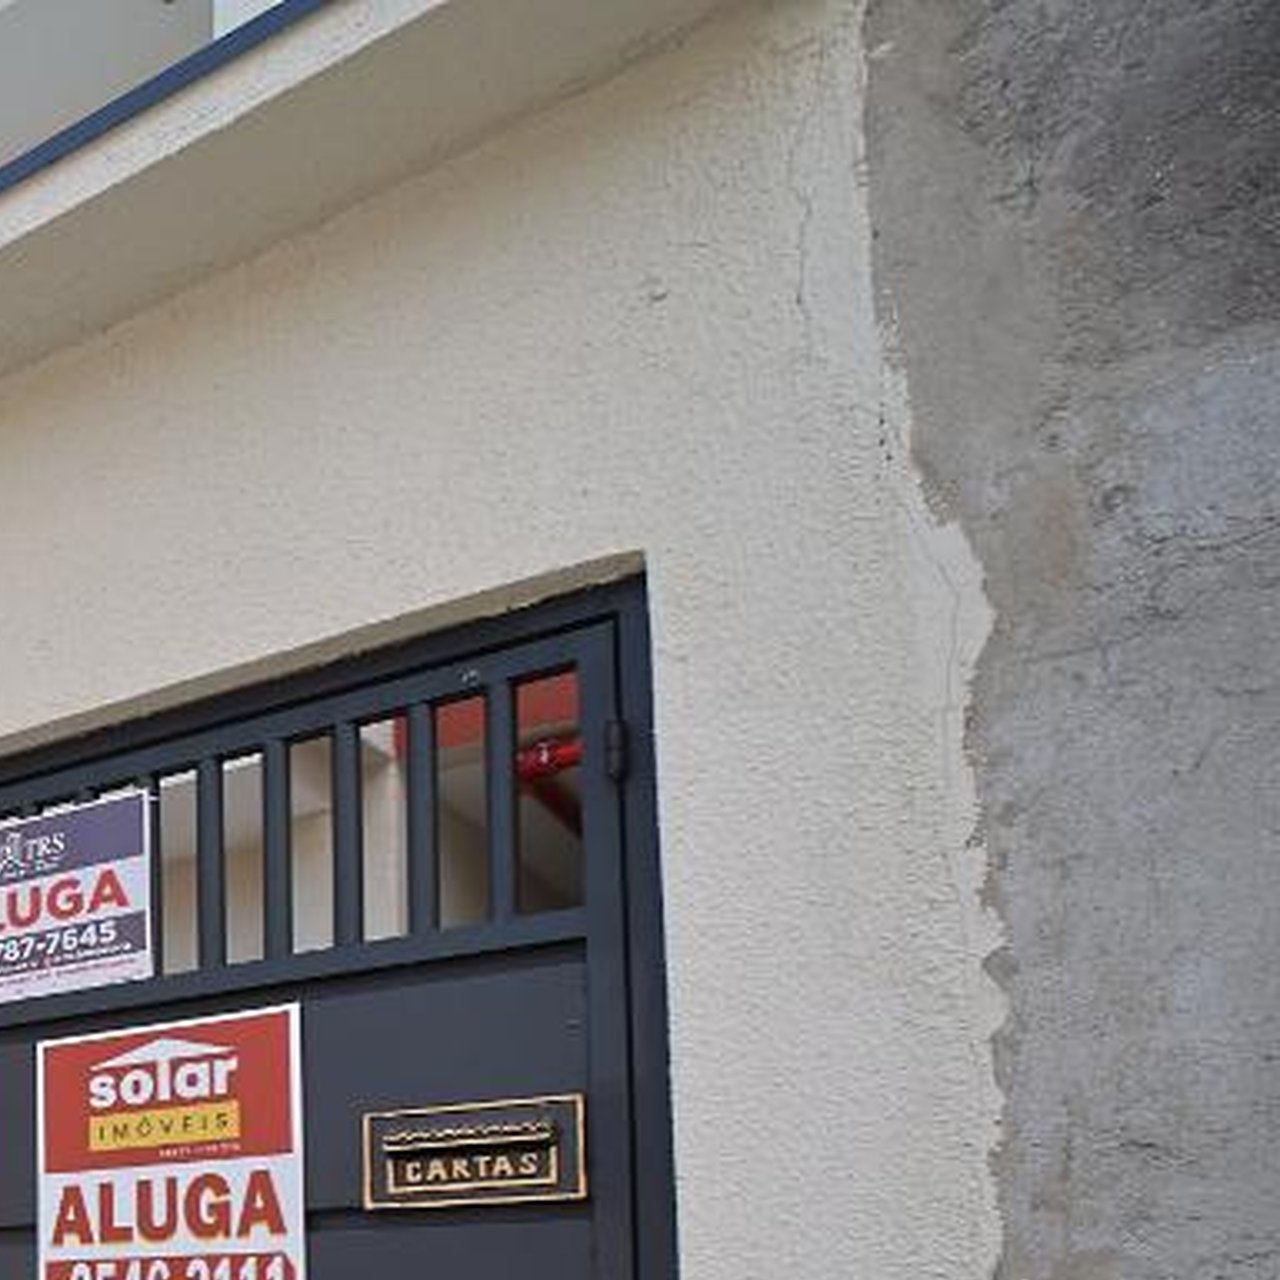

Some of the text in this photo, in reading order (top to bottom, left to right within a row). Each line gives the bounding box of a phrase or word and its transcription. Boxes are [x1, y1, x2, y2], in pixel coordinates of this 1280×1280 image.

[89, 1055, 239, 1108] solar
[405, 1152, 539, 1183] CARTAS
[52, 1169, 288, 1246] ALUGA
